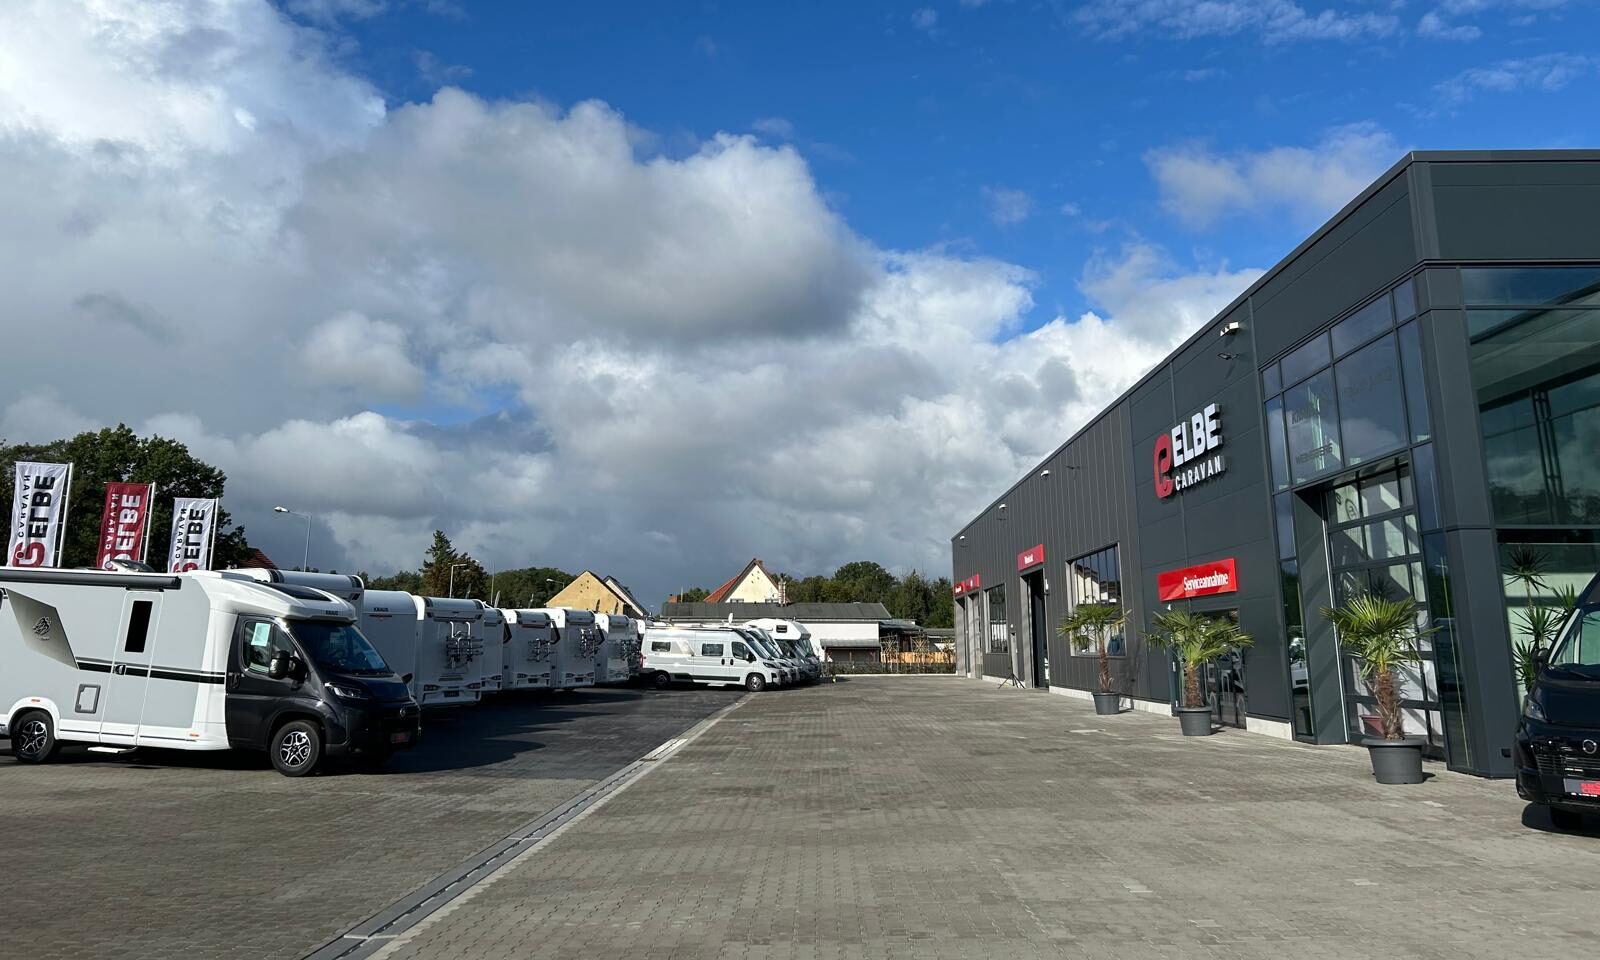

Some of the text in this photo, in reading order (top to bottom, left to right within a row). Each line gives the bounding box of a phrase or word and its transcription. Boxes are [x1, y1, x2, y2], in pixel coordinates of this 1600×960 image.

[1171, 402, 1221, 468] ELBE
[1175, 455, 1223, 491] CARAVAN
[1183, 570, 1229, 591] Serviceannahme
